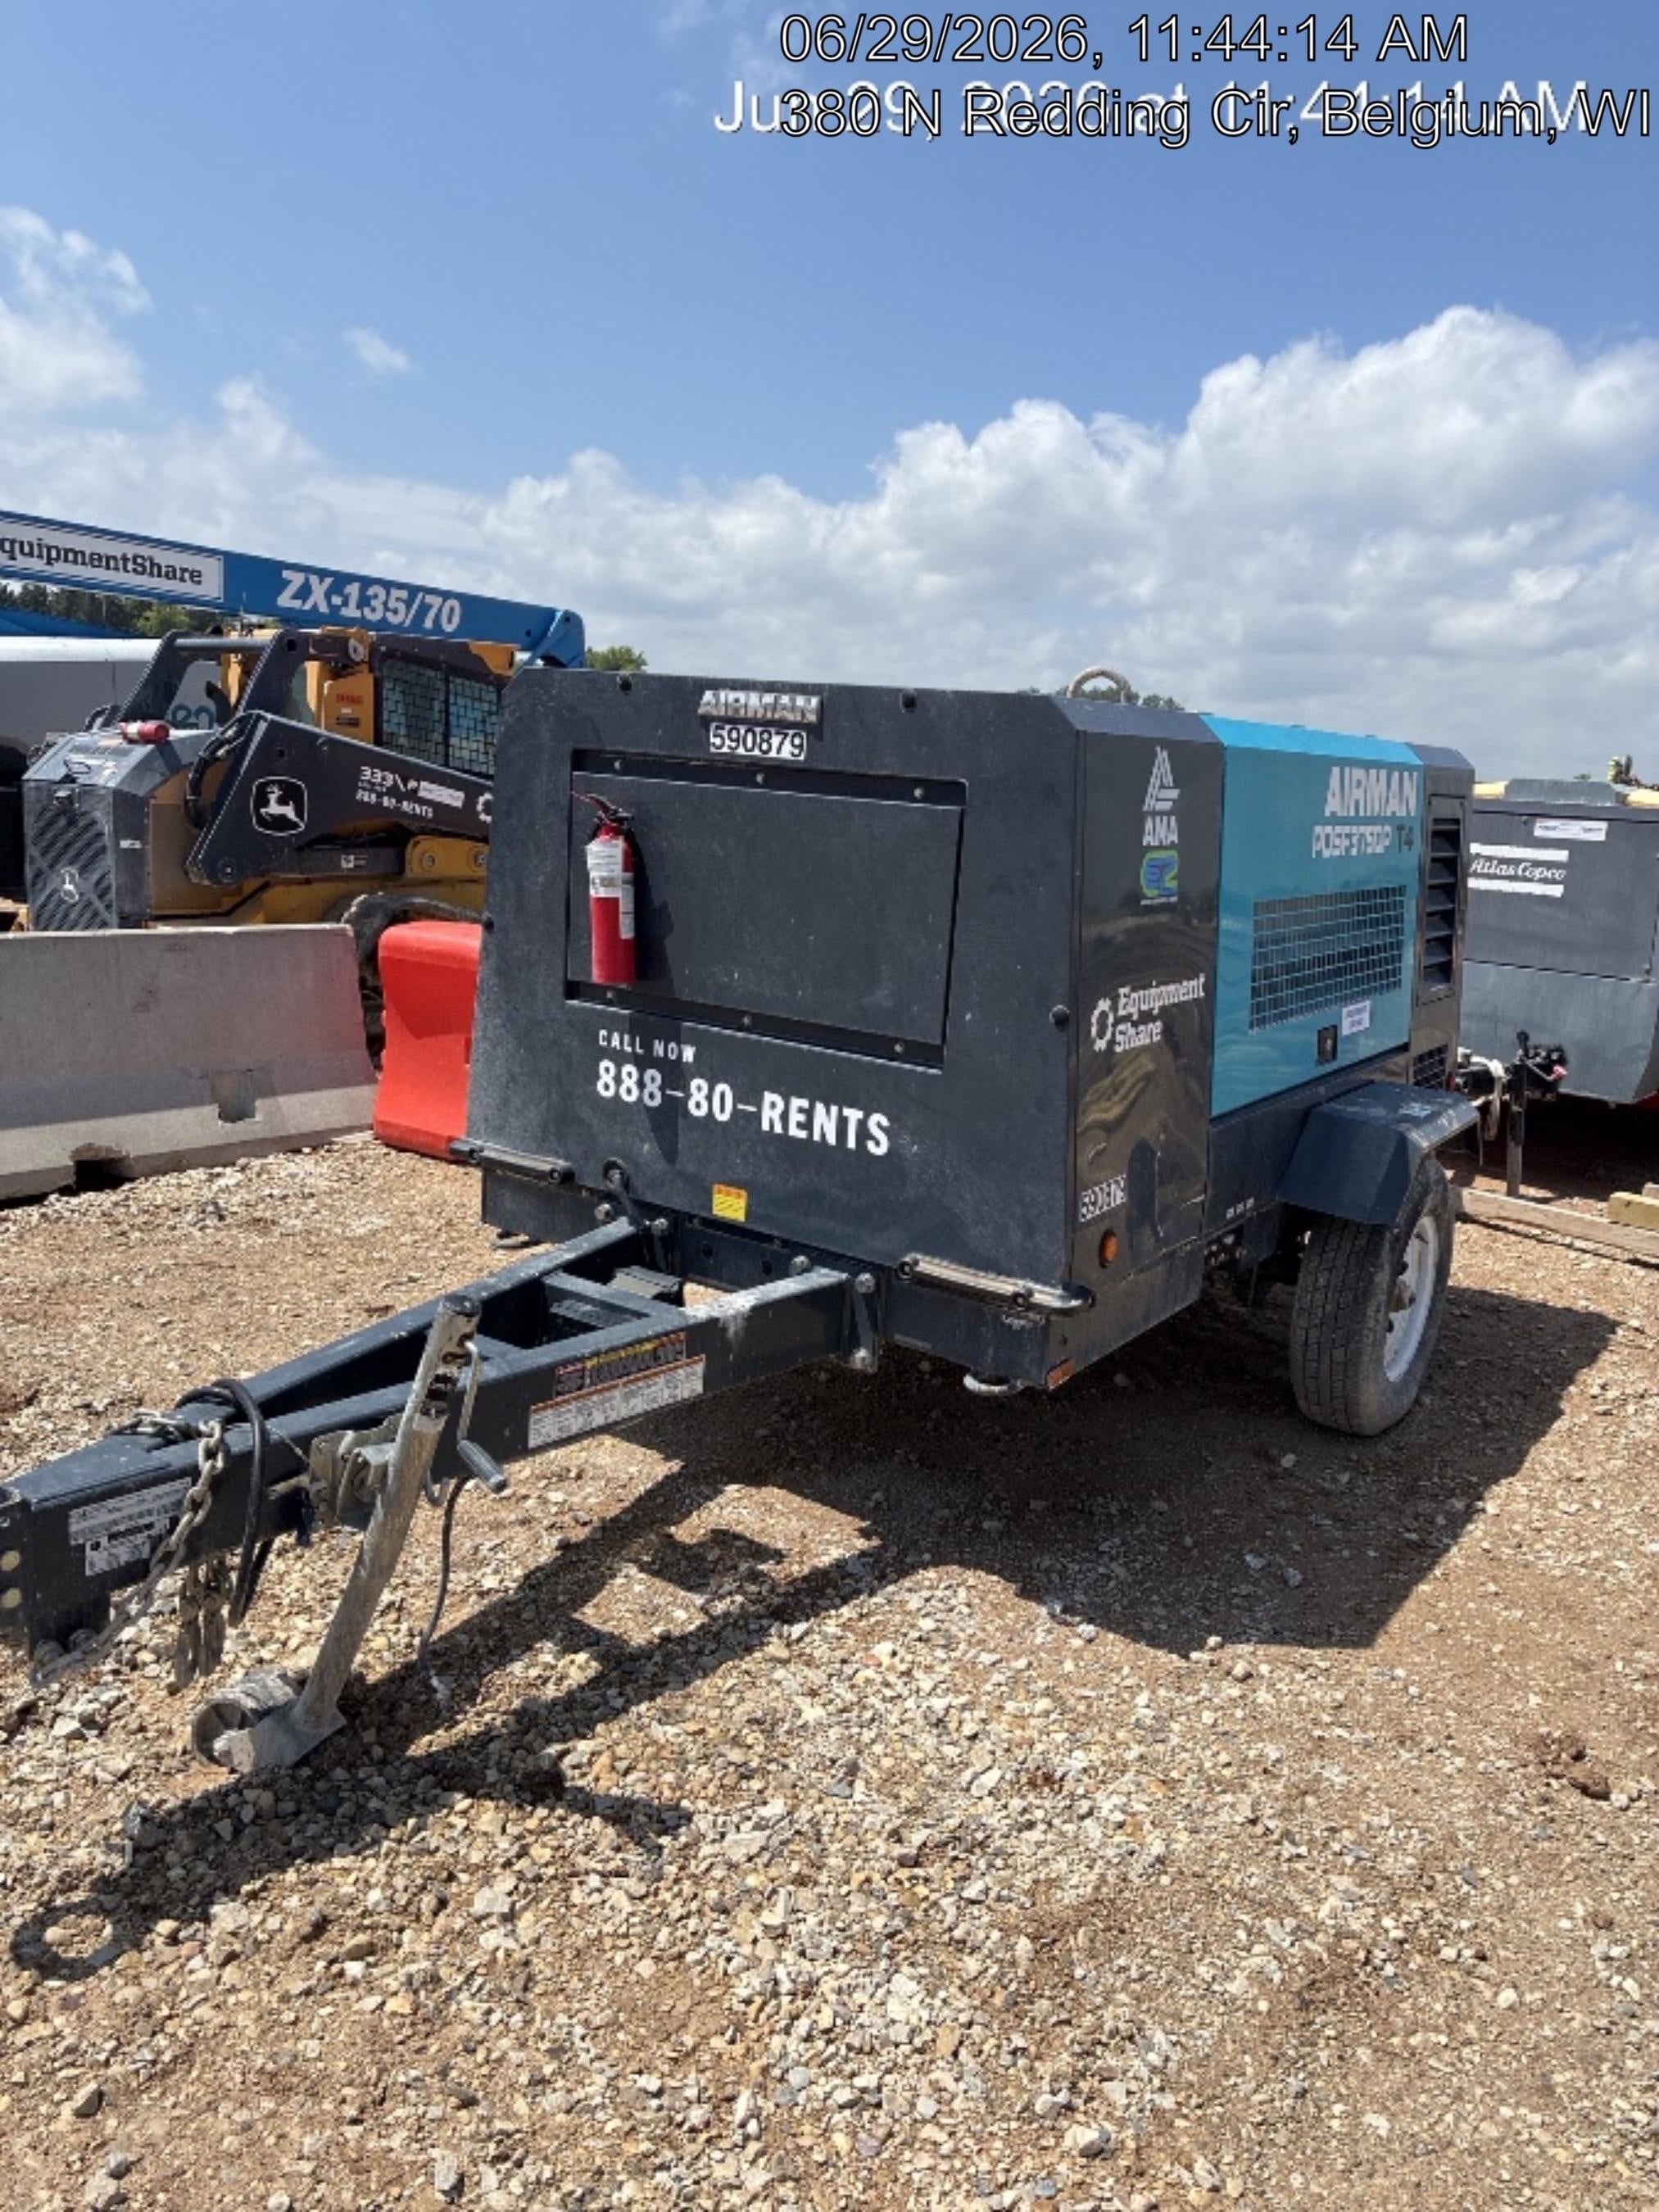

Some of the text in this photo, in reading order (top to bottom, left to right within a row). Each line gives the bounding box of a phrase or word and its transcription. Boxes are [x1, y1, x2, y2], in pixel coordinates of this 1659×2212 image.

[277, 569, 460, 632] ZX-135/70
[697, 688, 822, 723] AIRMAN
[710, 723, 806, 758] 590879
[1324, 766, 1419, 817] AIRMAN
[1470, 858, 1567, 882] Atlas Copco
[1117, 972, 1206, 1021] Equipment
[598, 1028, 696, 1063] CALL NOW
[1113, 1020, 1163, 1054] Share
[596, 1058, 891, 1157] 888-80-RENTS
